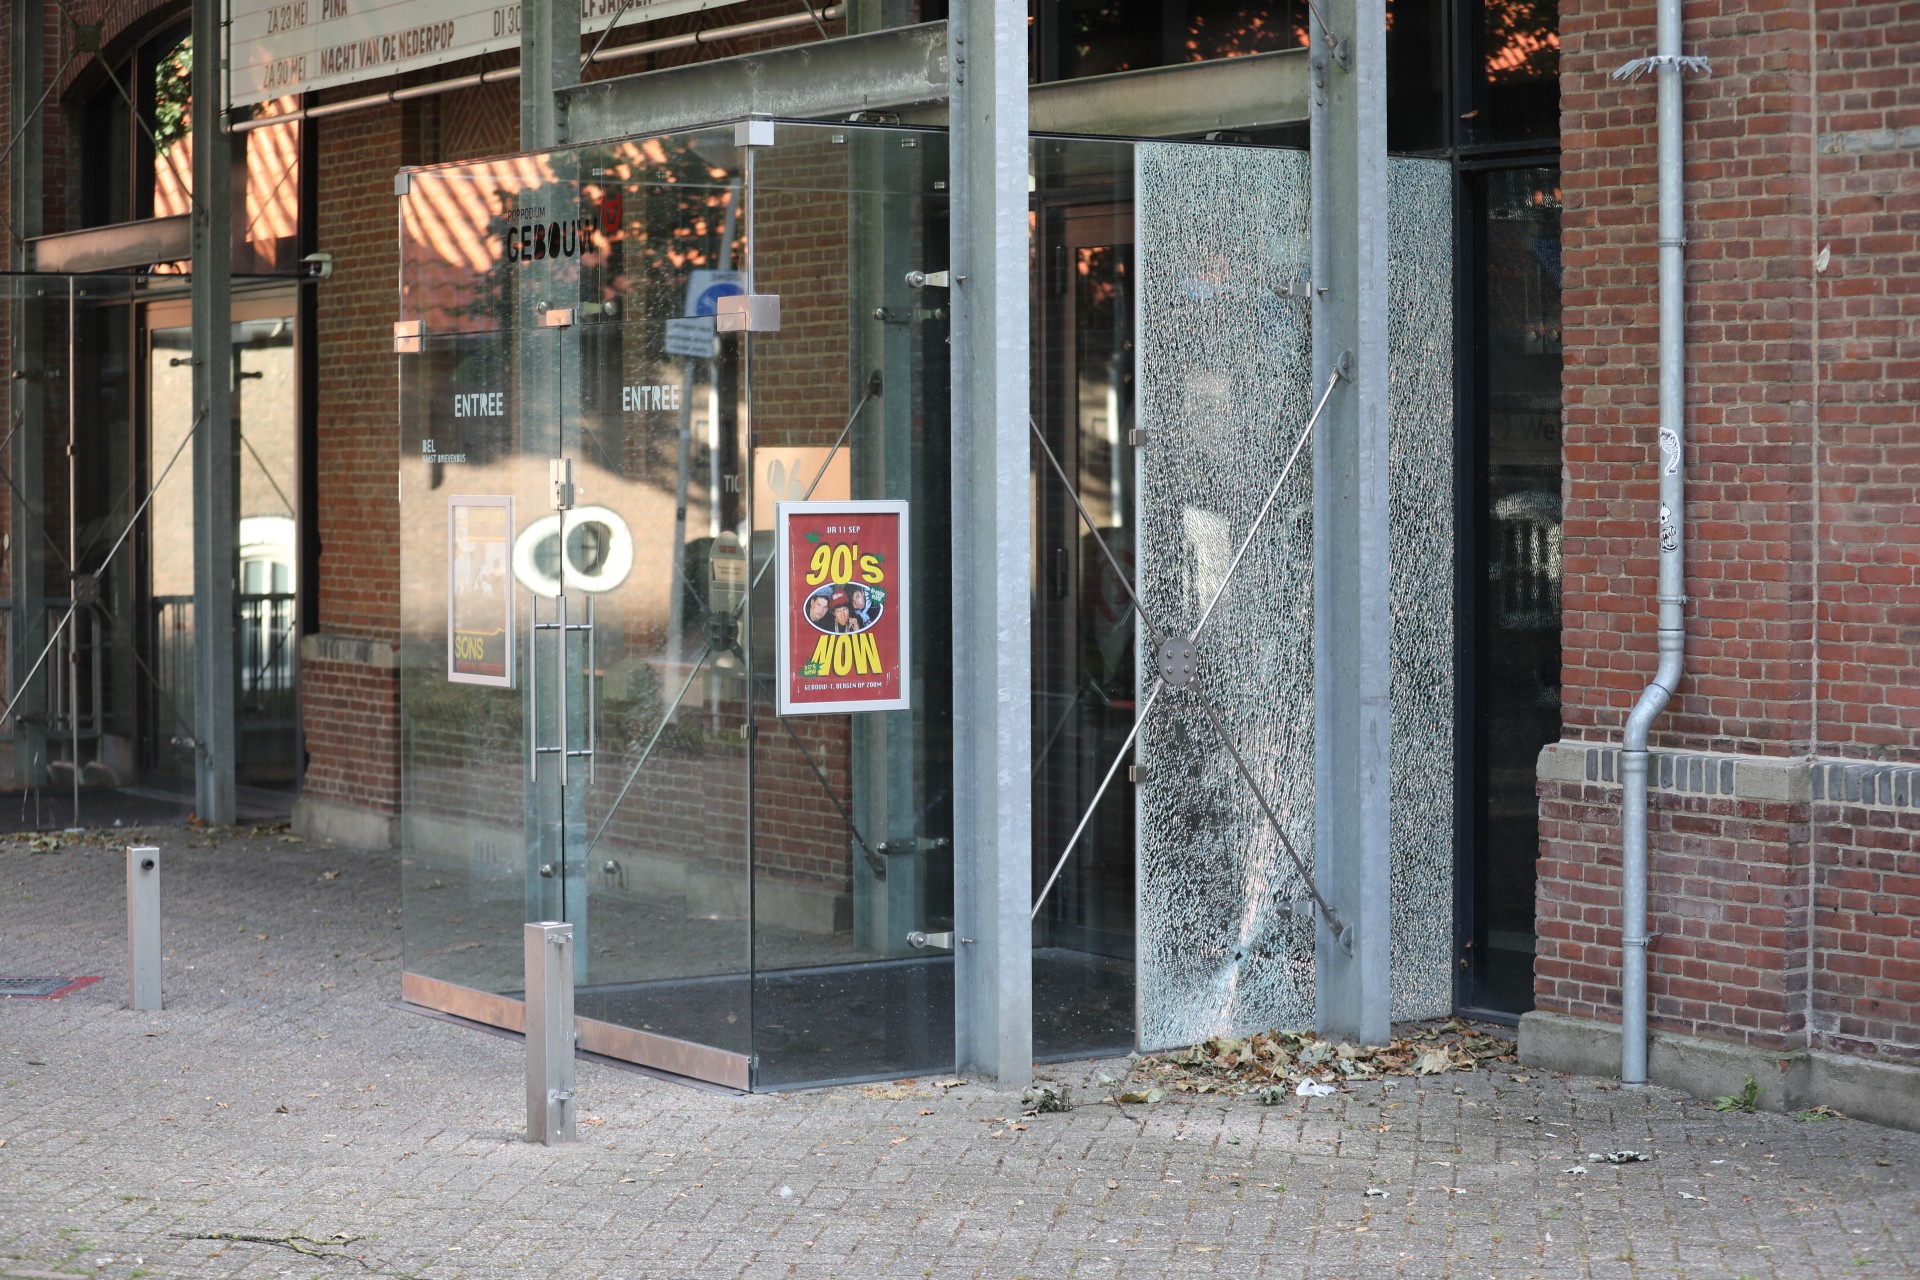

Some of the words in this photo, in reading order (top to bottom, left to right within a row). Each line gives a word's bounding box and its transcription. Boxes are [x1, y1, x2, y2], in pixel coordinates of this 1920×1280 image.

[267, 9, 279, 35] ZA
[280, 6, 292, 31] 23
[293, 2, 308, 28] MEI
[263, 61, 275, 89] ZA
[277, 60, 289, 85] 30
[291, 55, 307, 82] MEI
[320, 43, 356, 76] NACHT
[359, 39, 380, 67] VAN
[382, 34, 397, 62] DE
[399, 21, 455, 59] NEDERPOP
[493, 9, 505, 37] DI
[507, 206, 546, 222] POPPODIUM
[506, 218, 598, 263] GEBOUW
[454, 392, 504, 418] ENTREE
[622, 384, 680, 412] ENTREE
[422, 439, 436, 453] BEL
[838, 526, 846, 534] 11
[848, 525, 861, 534] SEP
[455, 635, 484, 660] SONS
[811, 632, 883, 676] NOW
[835, 682, 857, 690] BERGEN
[857, 681, 865, 689] OP
[866, 681, 882, 689] ZOOM
